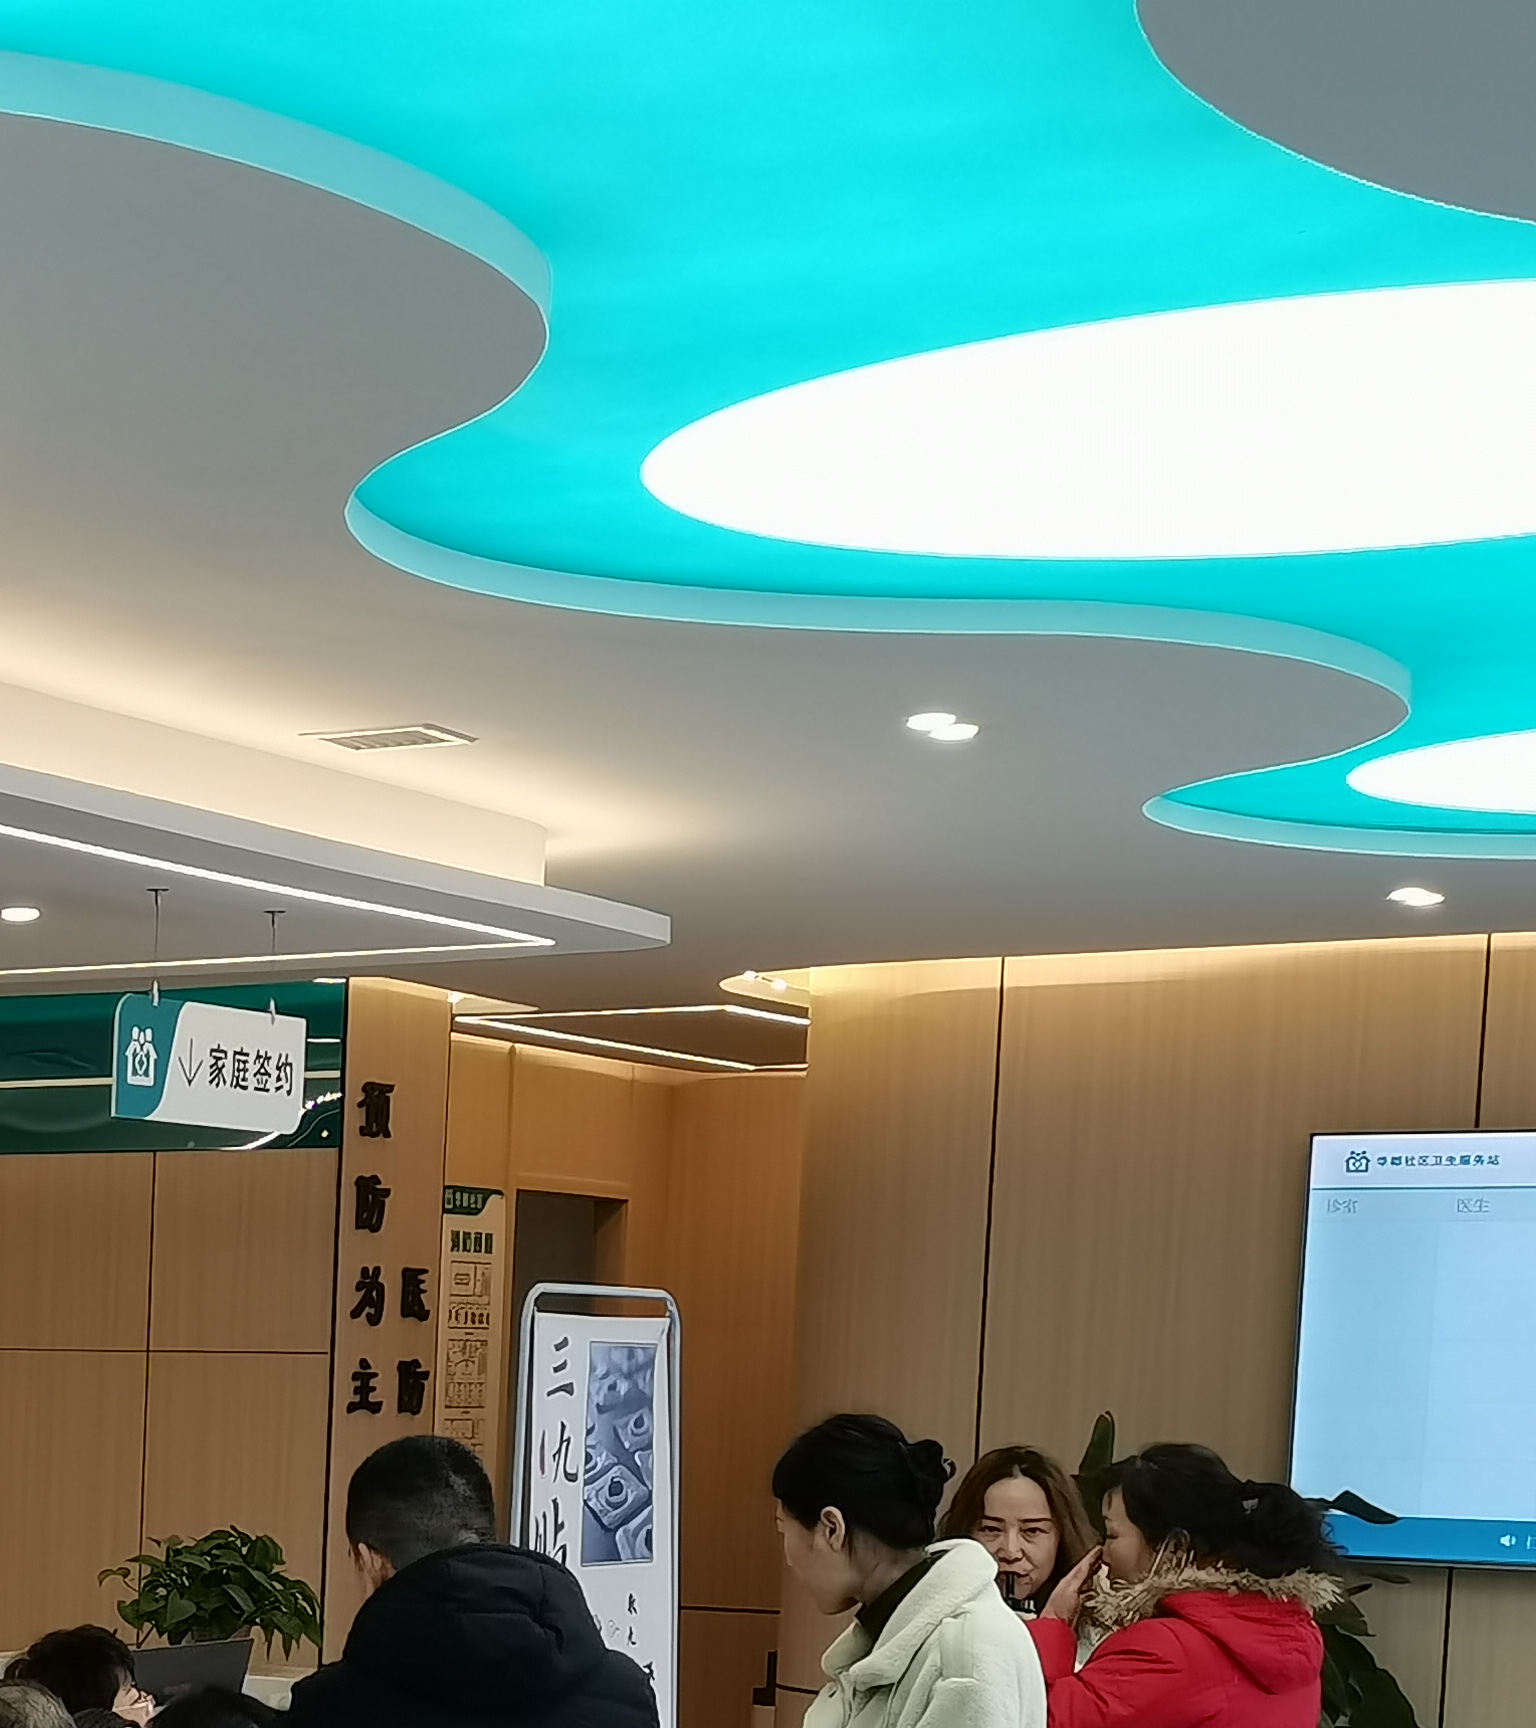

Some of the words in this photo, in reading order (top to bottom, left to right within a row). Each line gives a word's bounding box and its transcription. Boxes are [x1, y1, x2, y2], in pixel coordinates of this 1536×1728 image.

[208, 1042, 295, 1098] 家庭签约
[346, 1081, 397, 1415] 预防为主
